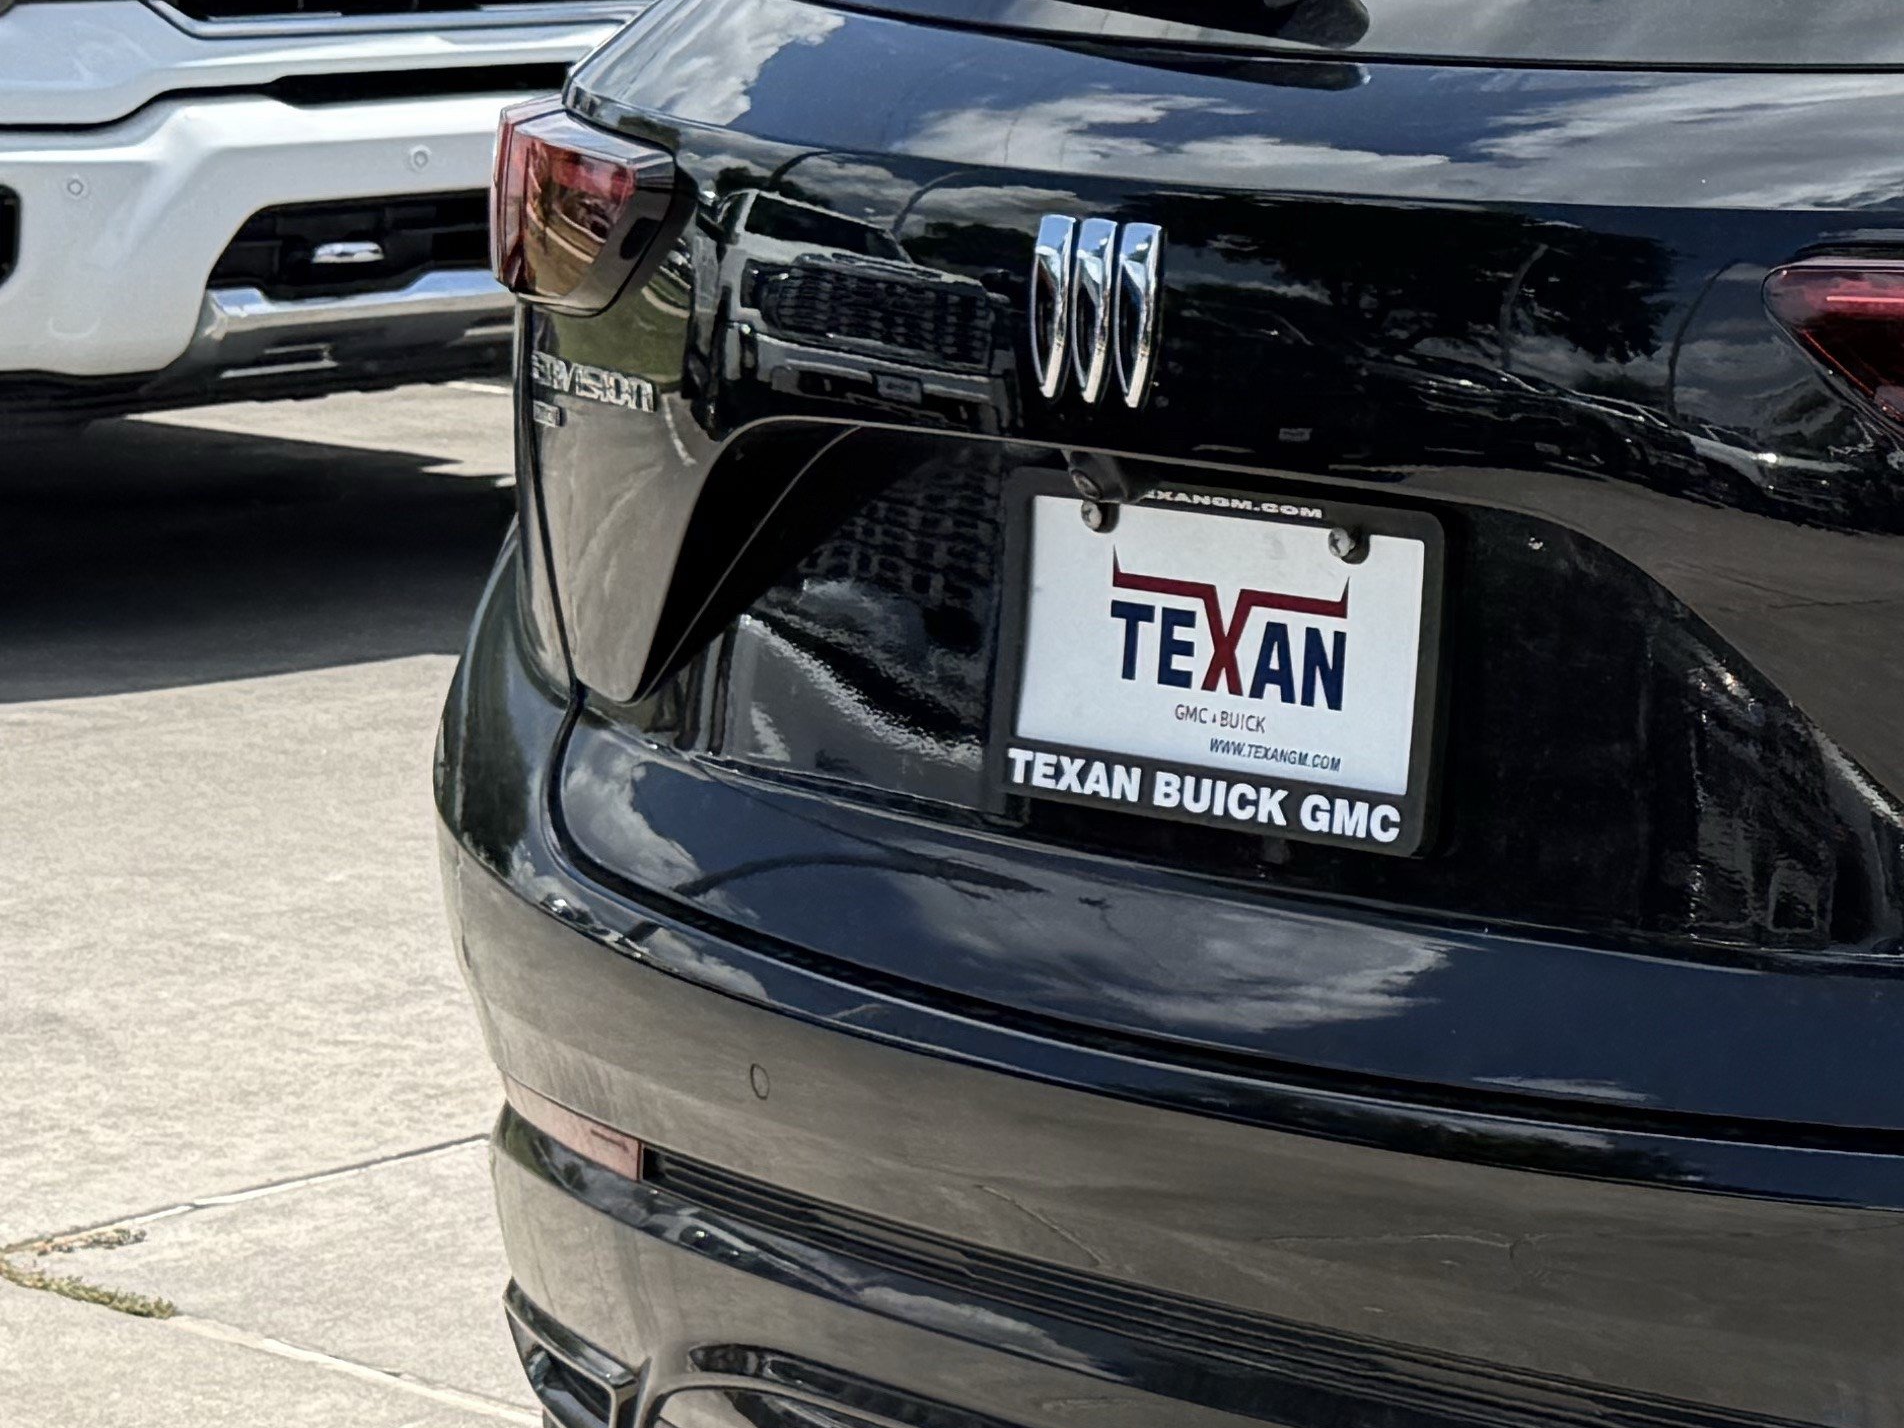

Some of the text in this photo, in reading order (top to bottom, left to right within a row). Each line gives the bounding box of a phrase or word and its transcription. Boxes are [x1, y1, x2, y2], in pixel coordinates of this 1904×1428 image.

[1111, 547, 1349, 711] TEXAN
[1174, 703, 1267, 734] GMC BUICK
[1208, 737, 1342, 772] WWW.TEXANGM.COM
[1007, 748, 1402, 843] TEXAN BUICK GMC
